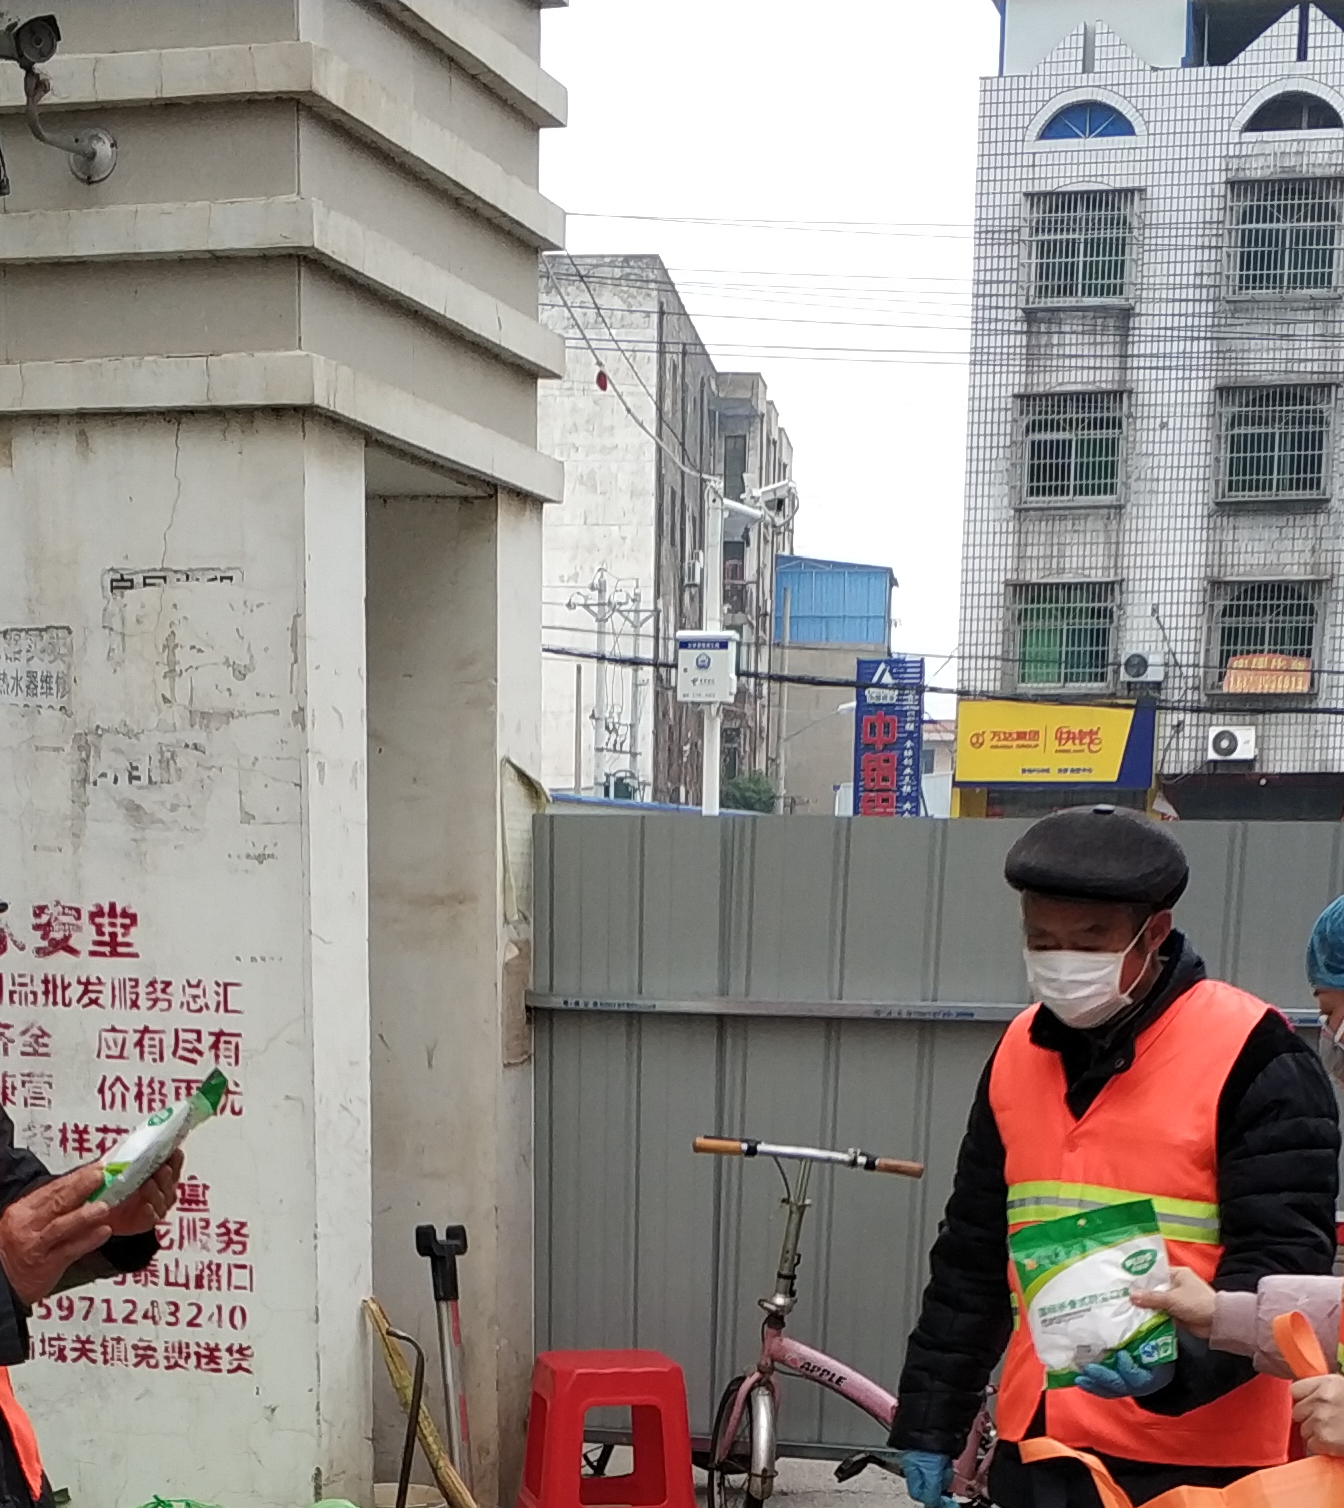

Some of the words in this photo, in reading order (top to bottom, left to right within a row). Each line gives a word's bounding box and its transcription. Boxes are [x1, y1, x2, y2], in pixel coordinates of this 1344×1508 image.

[95, 1023, 244, 1068] 应有尽有
[799, 1361, 848, 1388] APPLE
